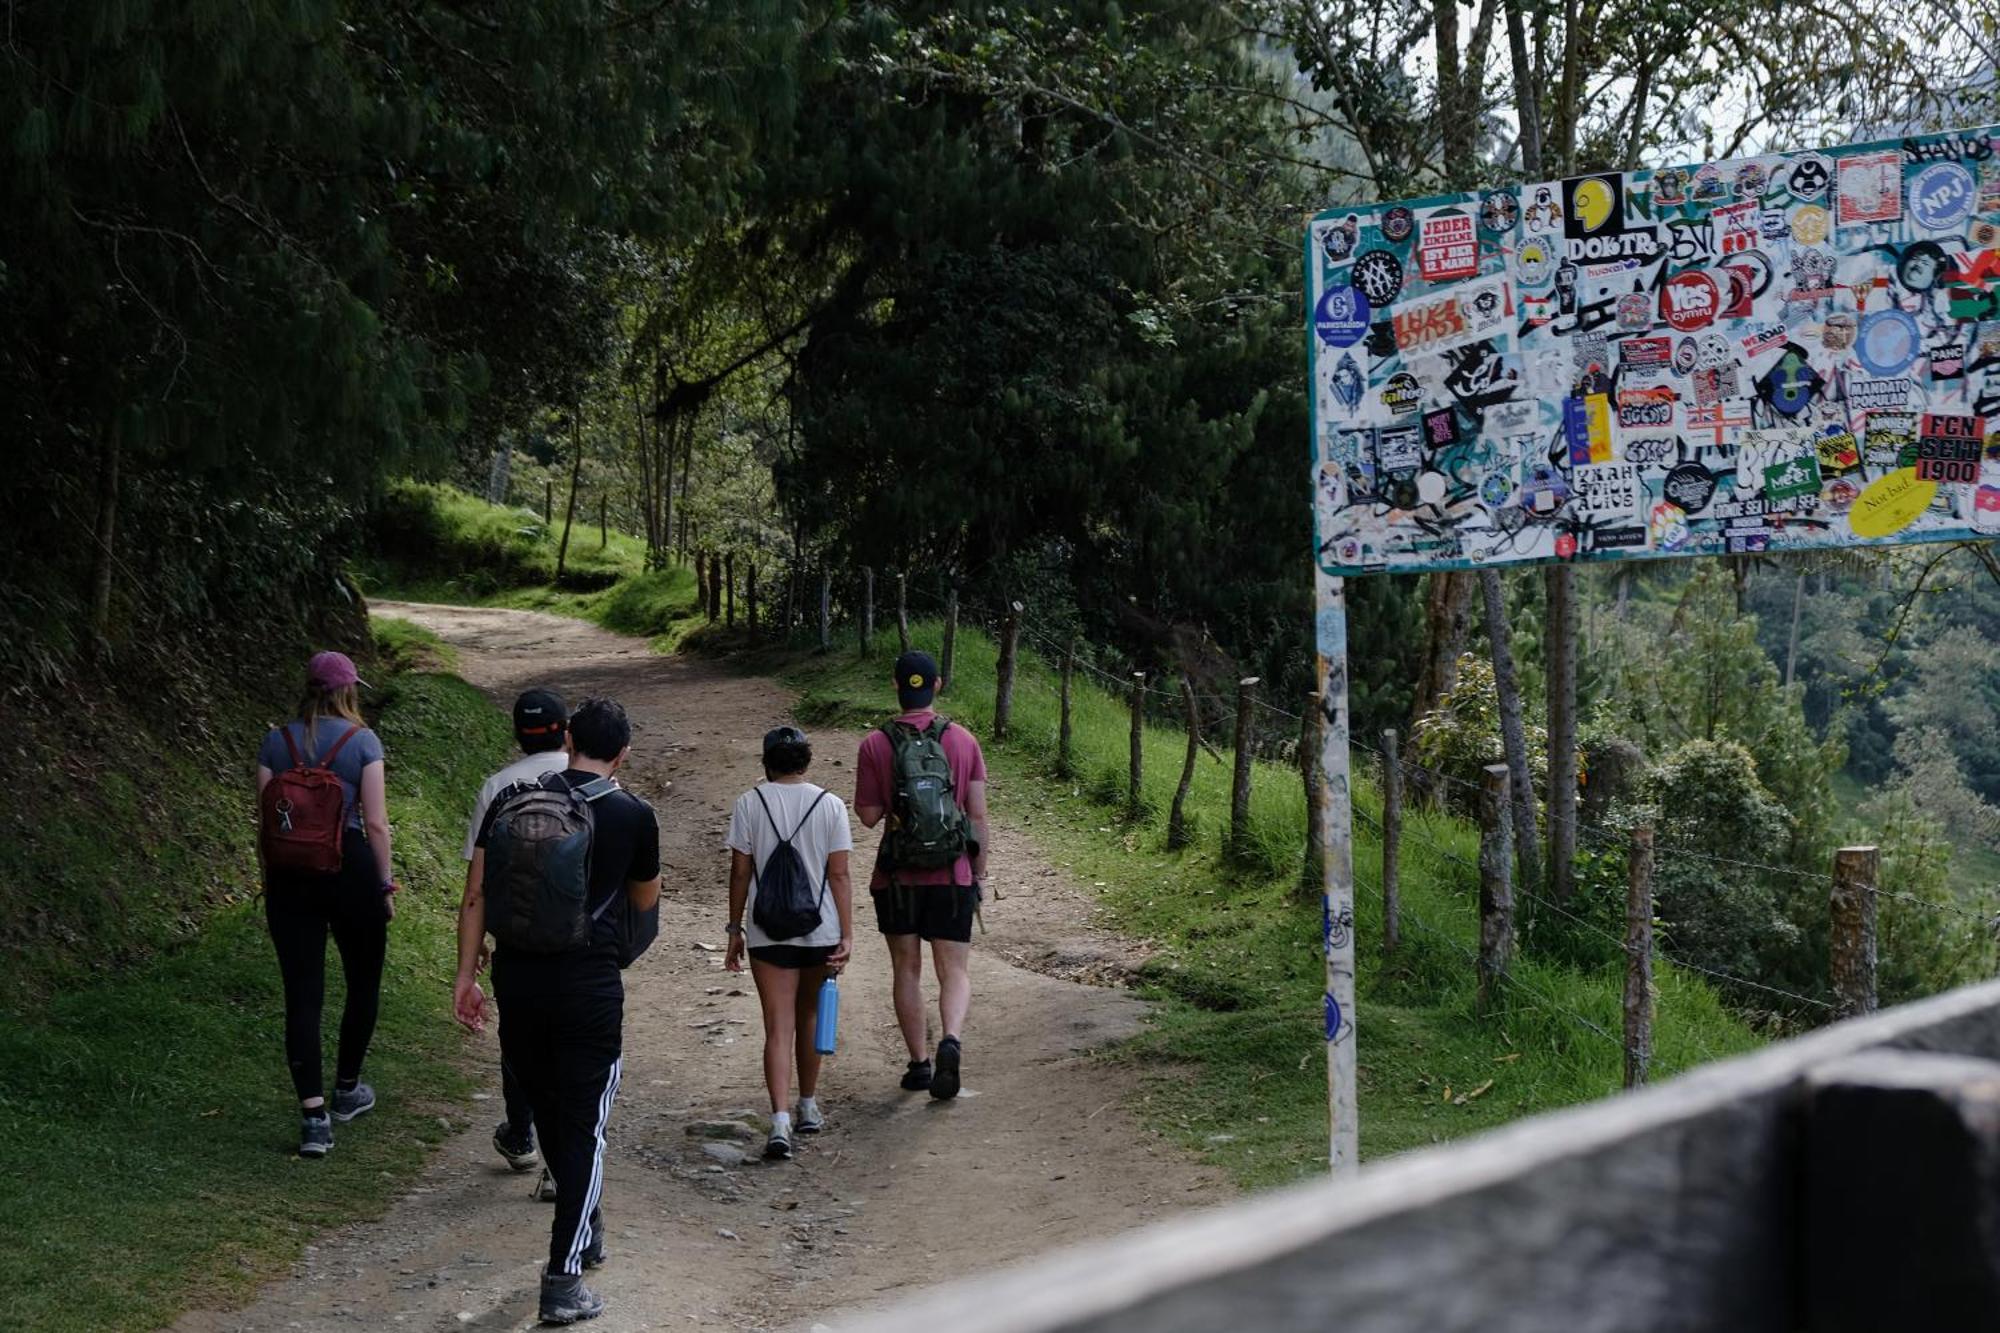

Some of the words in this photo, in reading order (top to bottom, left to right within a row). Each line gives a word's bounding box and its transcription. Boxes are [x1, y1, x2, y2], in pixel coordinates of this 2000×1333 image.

[1921, 177, 1964, 216] NPJ
[1424, 217, 1471, 235] JEDER
[1424, 231, 1473, 246] EINZELNE
[1424, 248, 1446, 261] IST
[1672, 307, 1713, 322] cymru
[1850, 379, 1911, 397] MANDATO
[1851, 392, 1909, 410] POPULAR
[1931, 416, 1976, 436] FCN
[1921, 437, 1982, 460] SEIT
[1921, 461, 1976, 482] 1900
